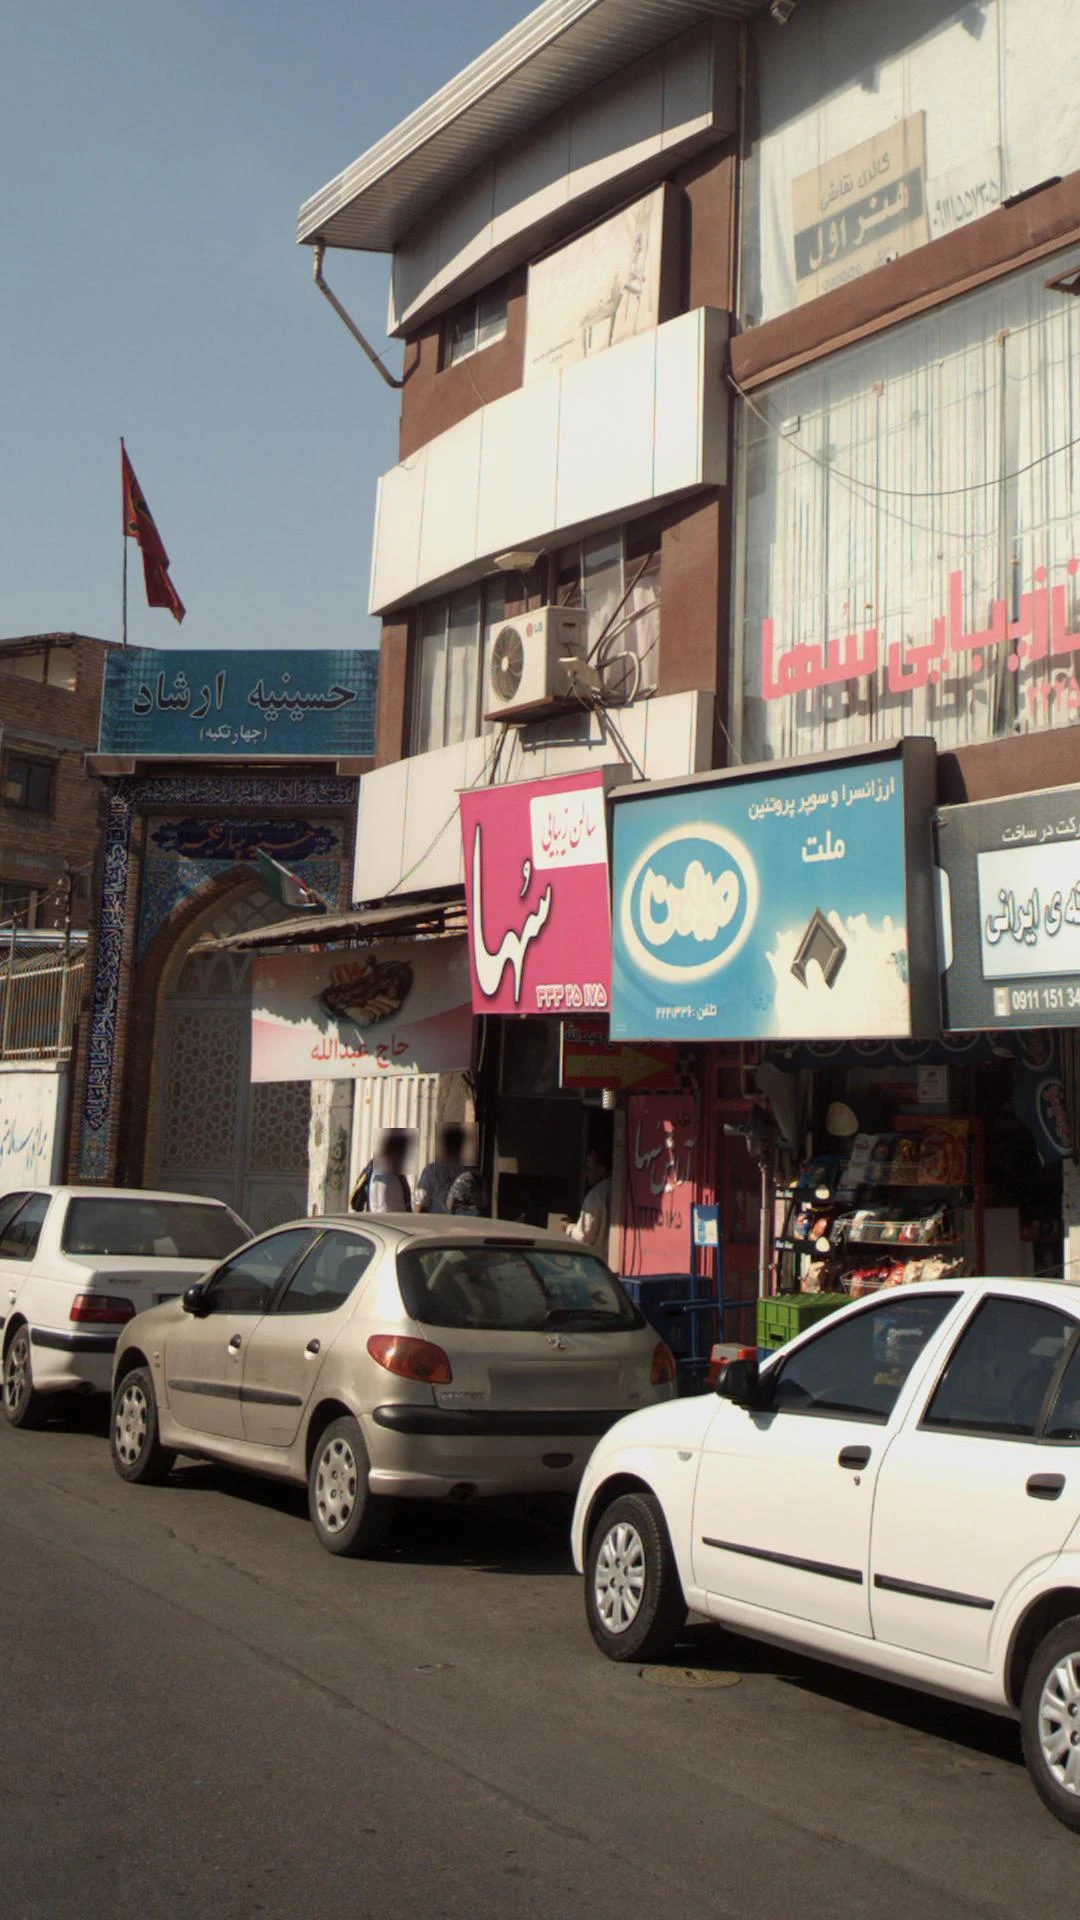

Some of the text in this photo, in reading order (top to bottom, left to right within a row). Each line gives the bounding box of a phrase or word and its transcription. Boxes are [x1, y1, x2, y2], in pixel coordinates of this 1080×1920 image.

[808, 219, 847, 272] اول
[132, 669, 358, 722] حسینیه ارشاد
[797, 791, 830, 817] سوپر
[830, 792, 839, 808] و
[841, 776, 895, 808] ارزانسرا
[801, 829, 846, 863] ملت
[1001, 823, 1037, 843] ساخت
[1039, 823, 1054, 842] در
[985, 887, 1041, 946] ایرانی
[1012, 989, 1040, 1011] 0911
[1044, 988, 1064, 1009] 151
[376, 1032, 410, 1069] حاج
